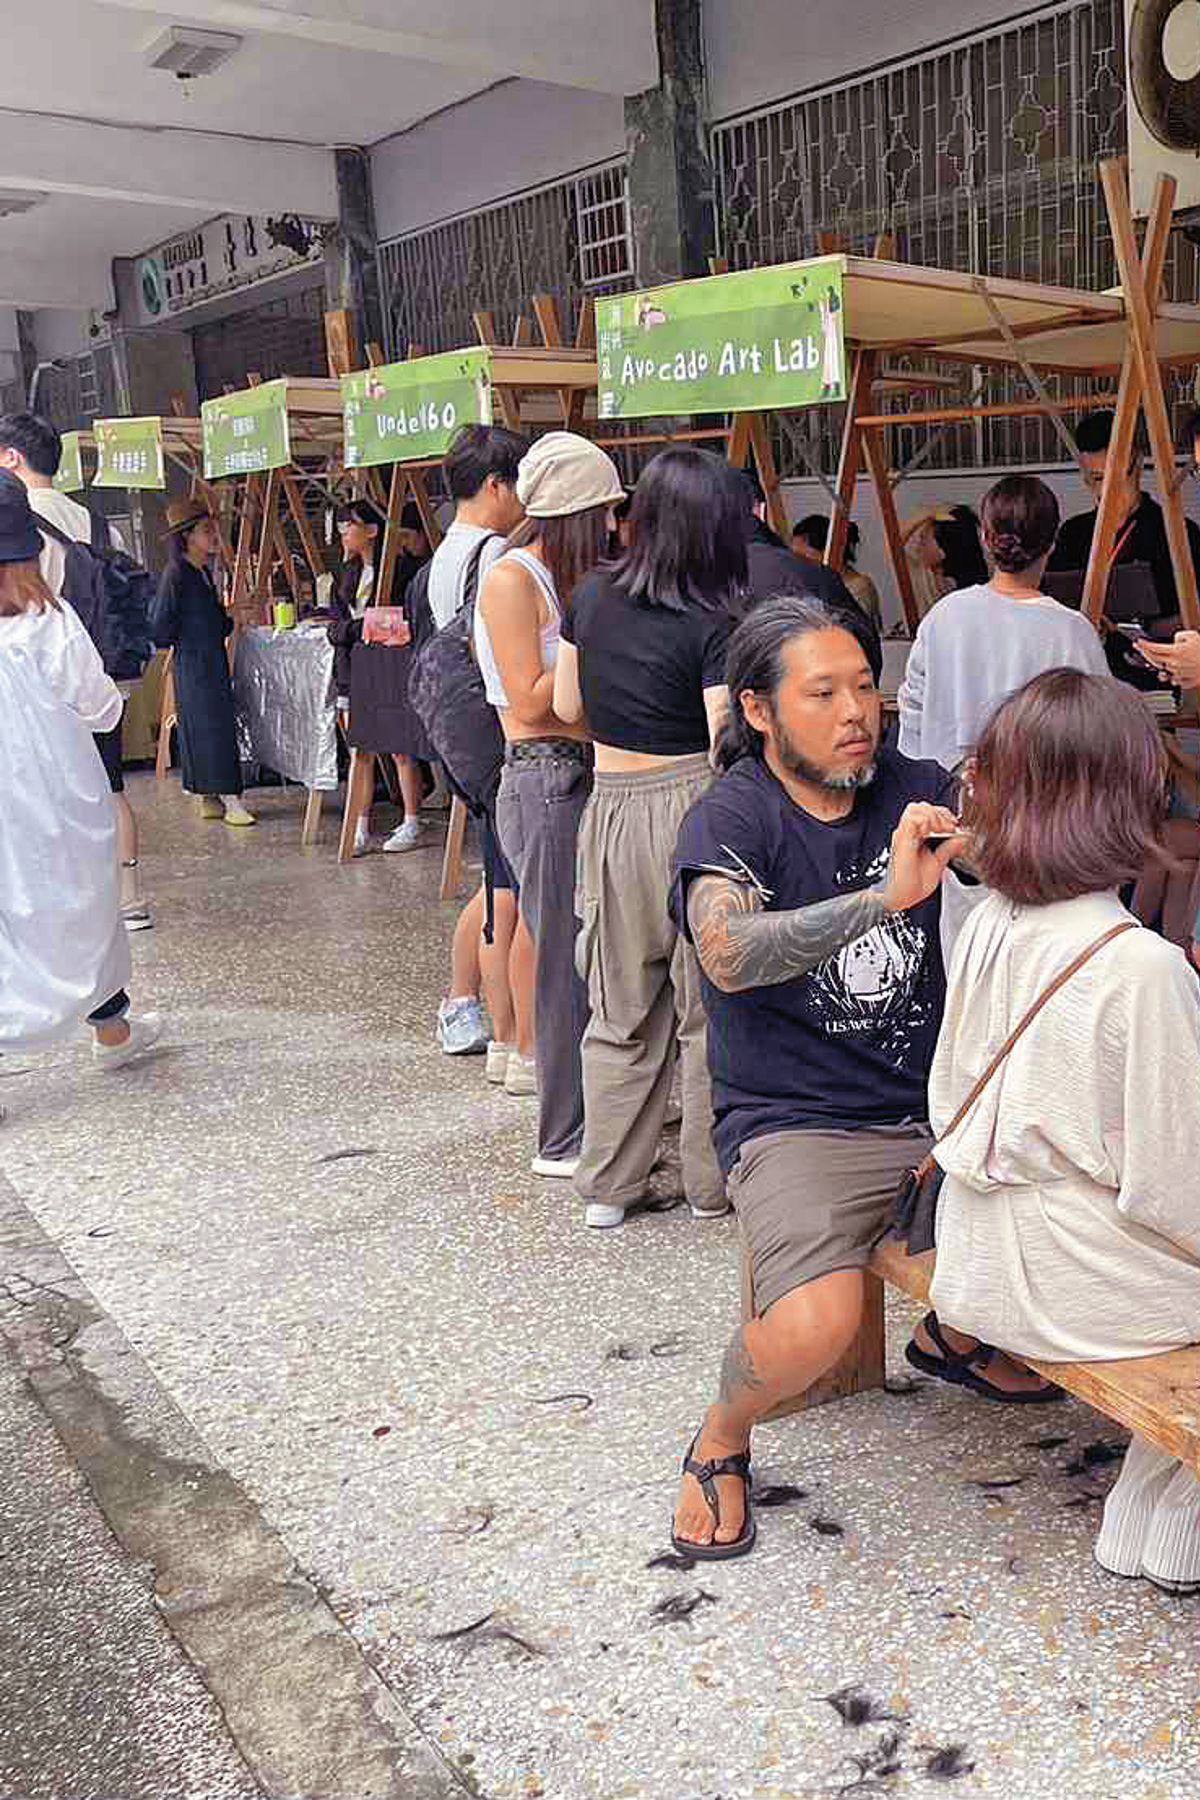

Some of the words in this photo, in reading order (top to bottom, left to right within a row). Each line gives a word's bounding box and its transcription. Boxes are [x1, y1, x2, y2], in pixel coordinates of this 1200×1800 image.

[621, 350, 709, 387] Avocado
[718, 342, 763, 376] Art
[774, 336, 820, 374] Lab
